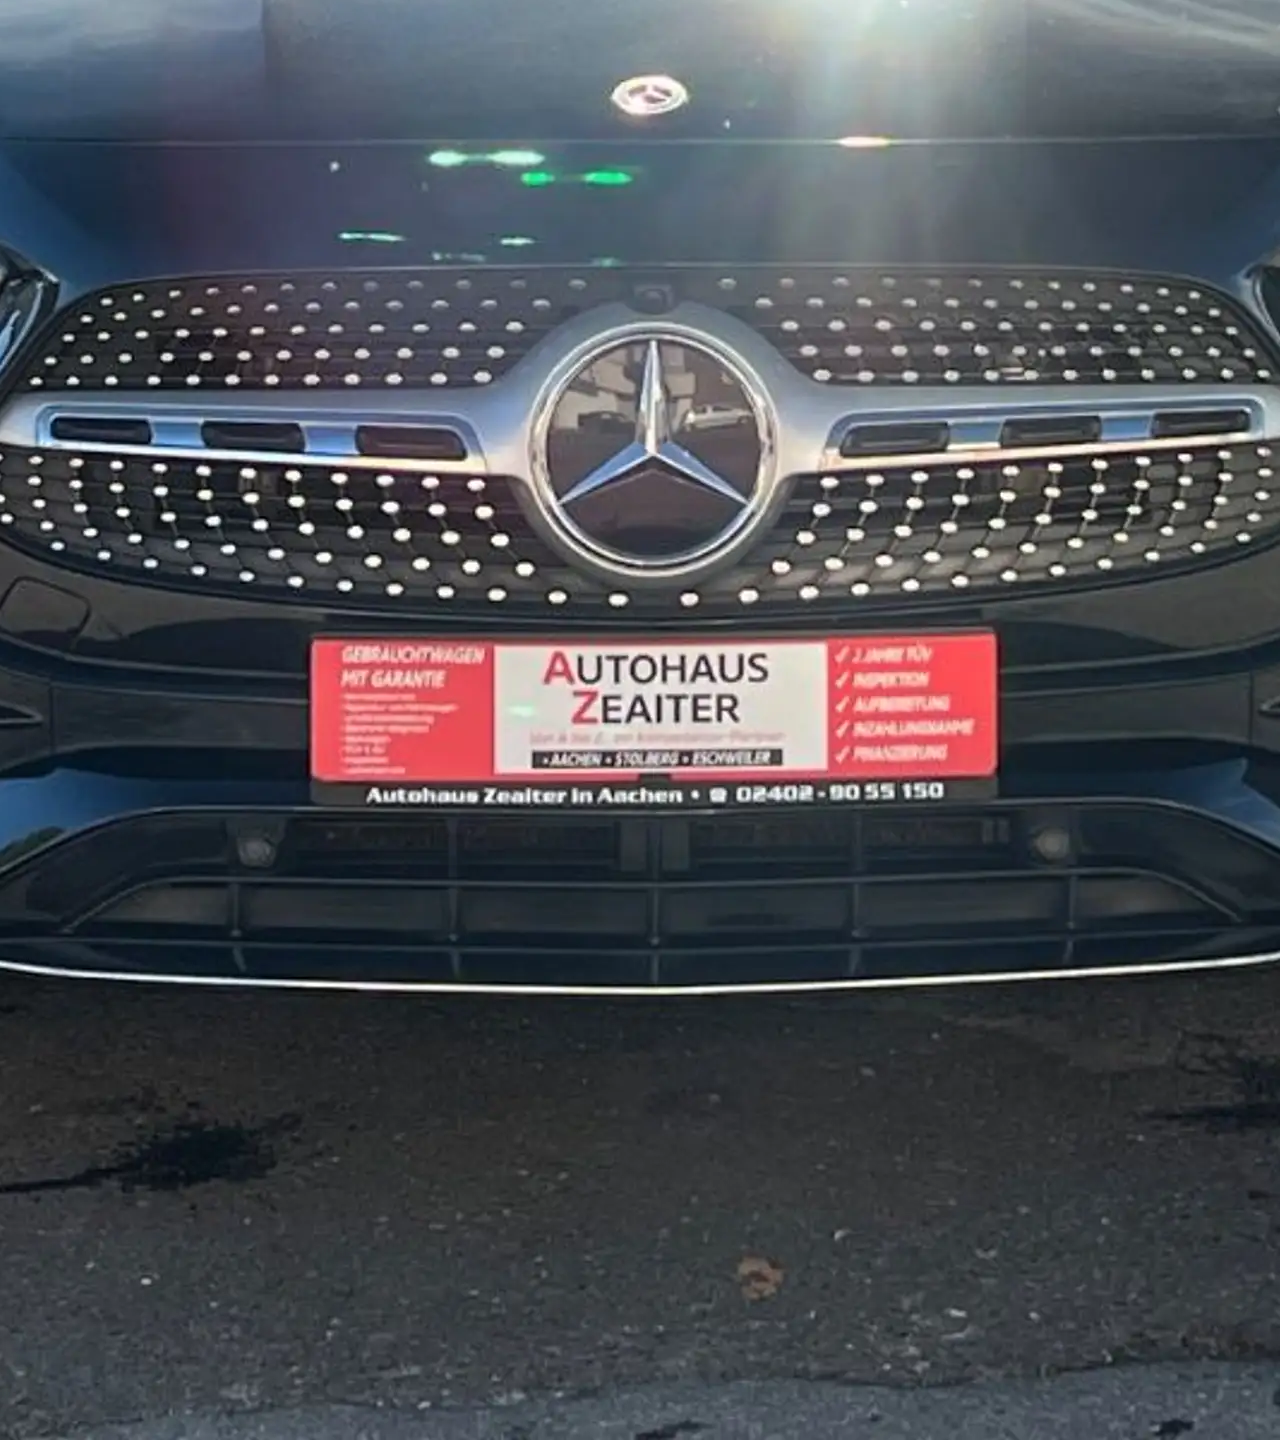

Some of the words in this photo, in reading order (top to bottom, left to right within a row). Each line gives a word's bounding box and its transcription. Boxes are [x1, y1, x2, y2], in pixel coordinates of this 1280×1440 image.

[341, 645, 485, 664] GEBRAUCHTWAGEN
[341, 669, 369, 688] MIT
[371, 669, 446, 688] GARANTIE
[543, 651, 769, 685] AUTOHAUS
[572, 690, 740, 725] ZEAITER
[549, 751, 602, 767] AACHEN
[616, 750, 679, 767] STOLBERG
[692, 750, 771, 766] ESCHWEILER
[366, 787, 480, 805] Autohaus
[483, 786, 567, 805] Zeaiter
[572, 786, 594, 804] in
[597, 786, 683, 804] Aachen
[736, 784, 815, 803] 02402
[829, 783, 860, 802] 90
[864, 782, 896, 801] 55
[901, 781, 945, 800] 150
